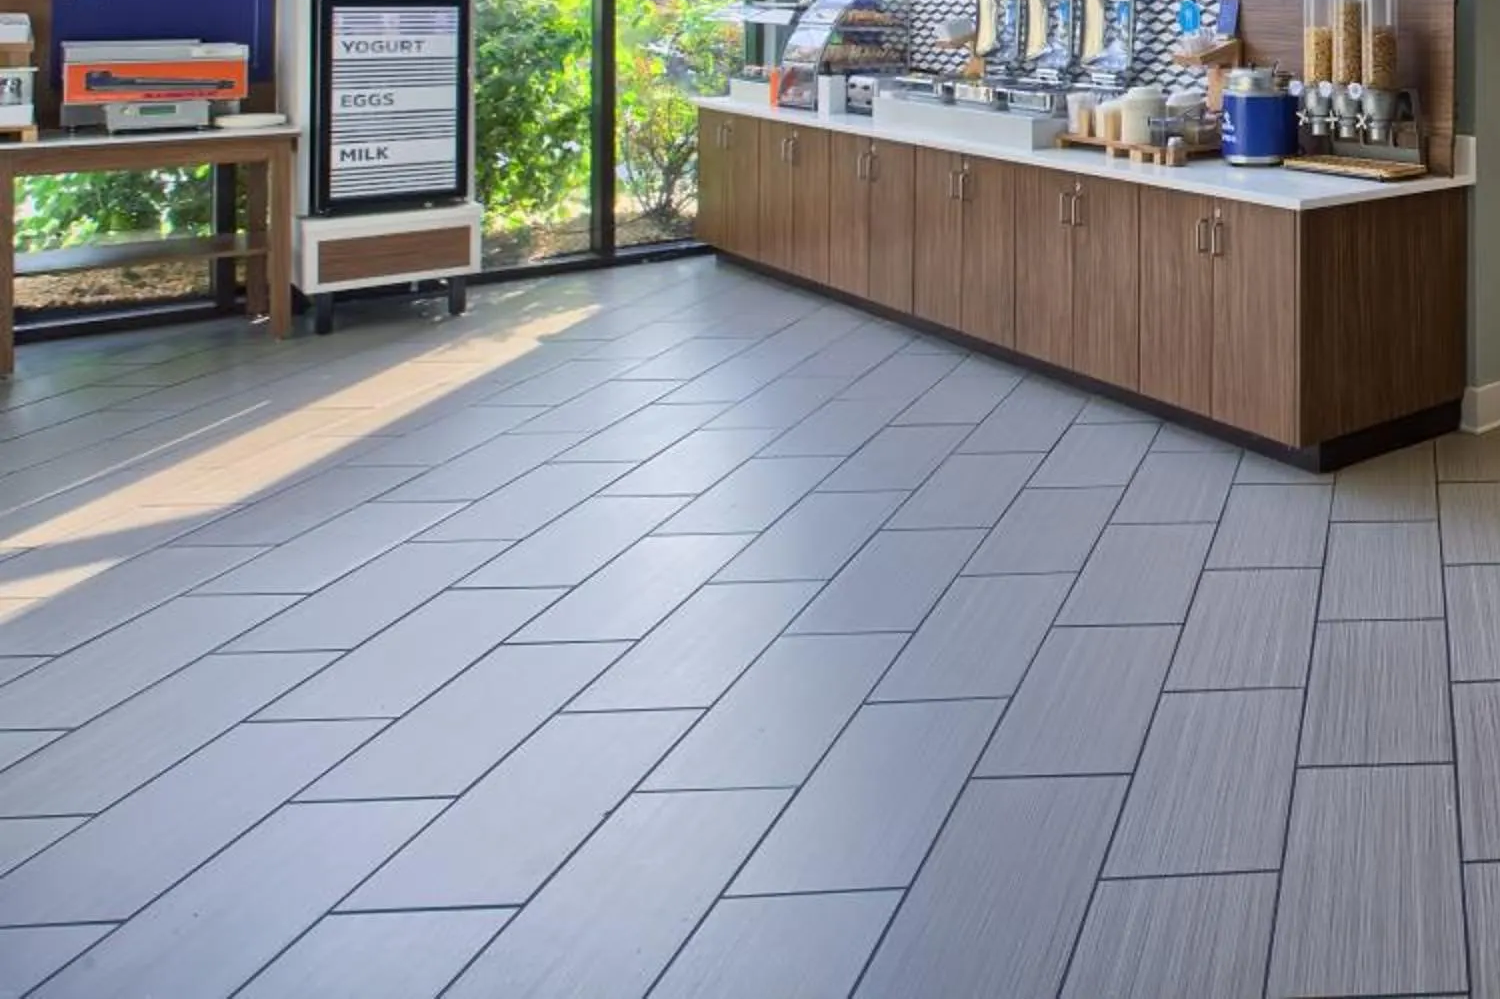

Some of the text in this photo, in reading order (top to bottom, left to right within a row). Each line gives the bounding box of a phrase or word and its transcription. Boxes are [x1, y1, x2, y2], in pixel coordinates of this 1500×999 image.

[342, 39, 425, 54] YOGURT
[340, 92, 395, 108] EGGS
[340, 146, 389, 162] MILK
